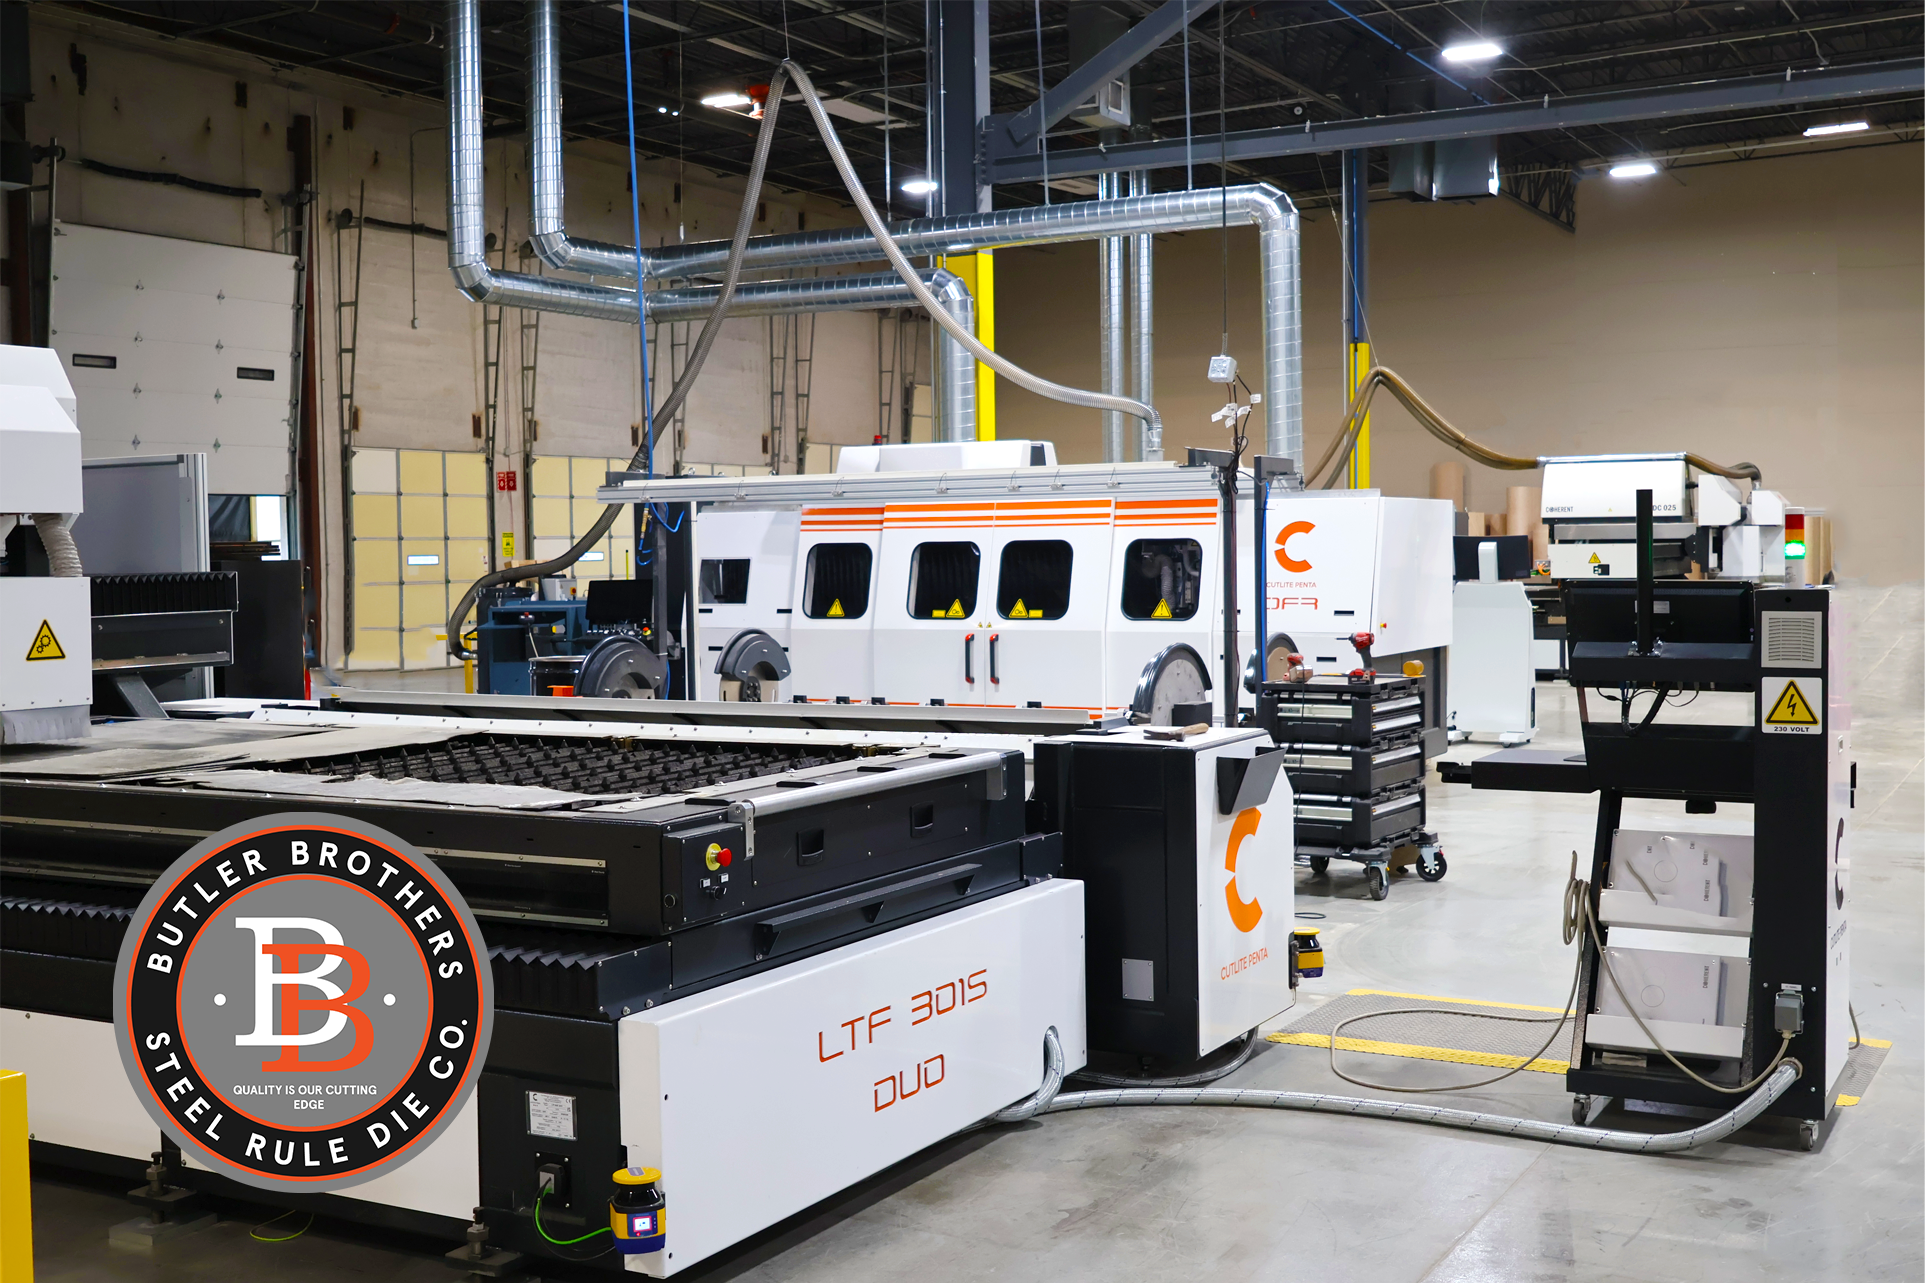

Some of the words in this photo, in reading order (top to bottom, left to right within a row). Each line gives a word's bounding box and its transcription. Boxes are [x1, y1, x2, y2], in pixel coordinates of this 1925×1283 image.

[1220, 956, 1247, 980] CUTLITE
[1248, 946, 1269, 968] PENTA
[818, 1005, 892, 1063] LTF
[873, 1053, 946, 1113] DUO
